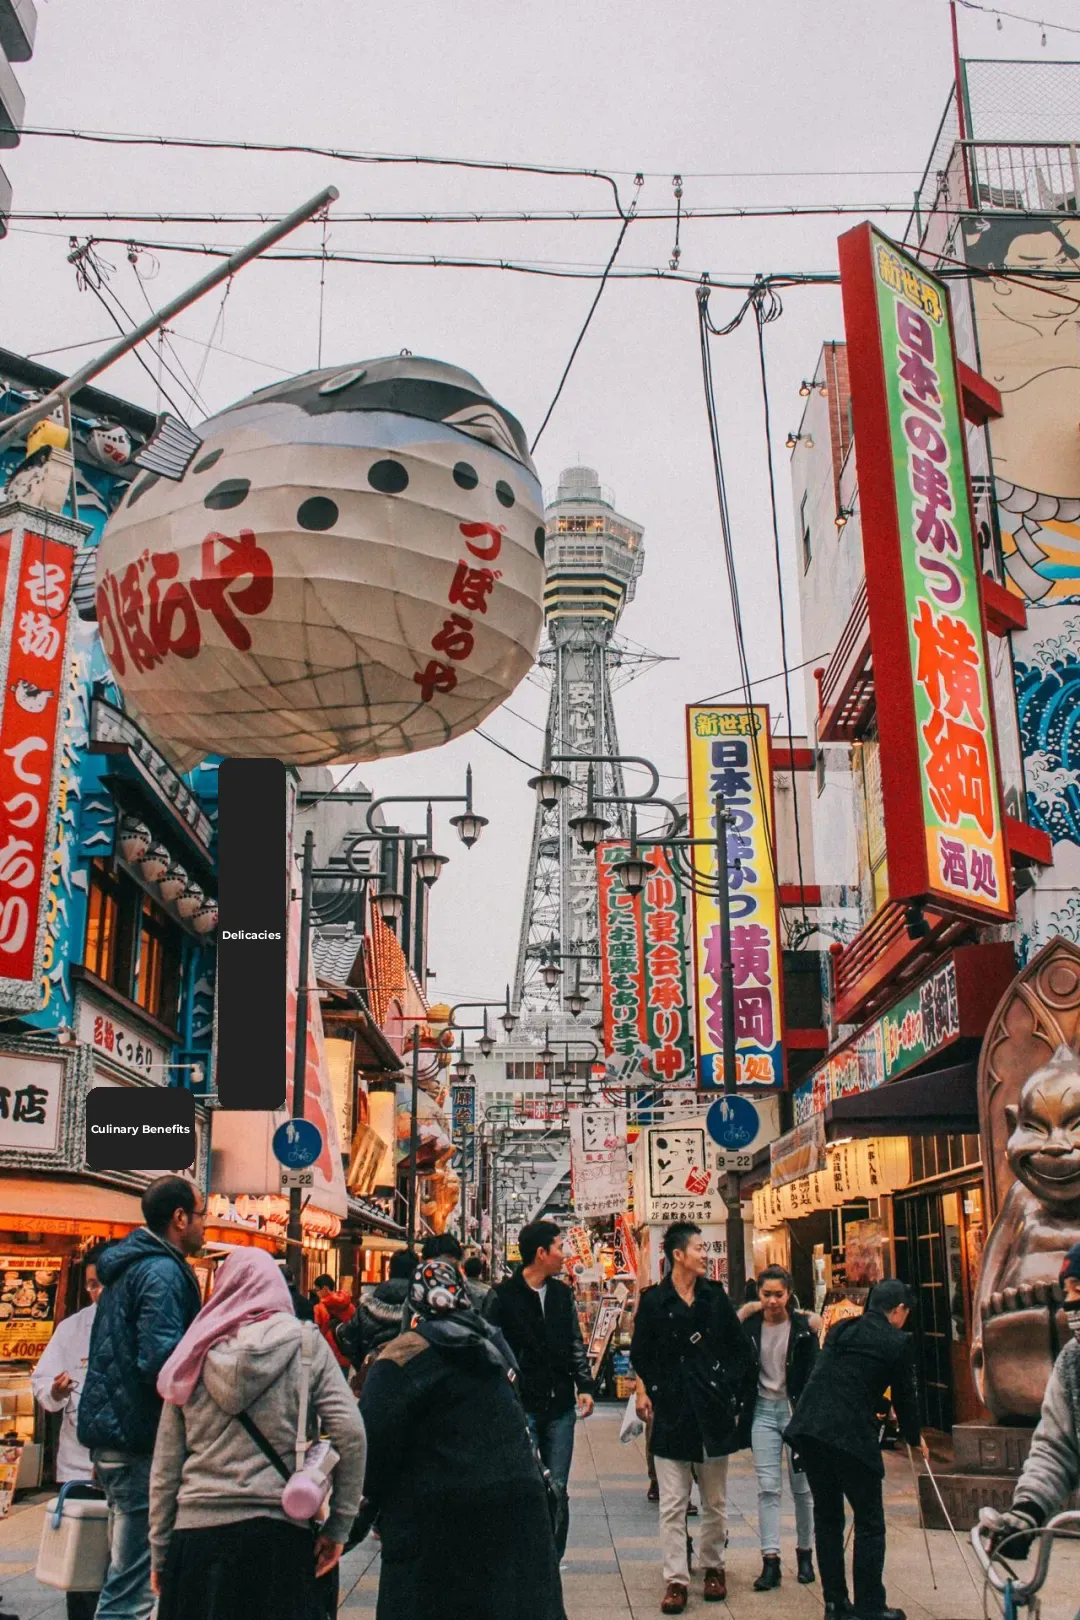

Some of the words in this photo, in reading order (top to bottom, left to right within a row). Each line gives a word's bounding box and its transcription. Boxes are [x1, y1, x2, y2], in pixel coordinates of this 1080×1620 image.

[877, 246, 943, 327] 新世界
[695, 713, 761, 736] 新世界
[0, 736, 49, 954] てっちり
[940, 837, 998, 898] 酒処
[643, 846, 685, 1081] 大小宴会承り中
[662, 1201, 712, 1210] カウンター席
